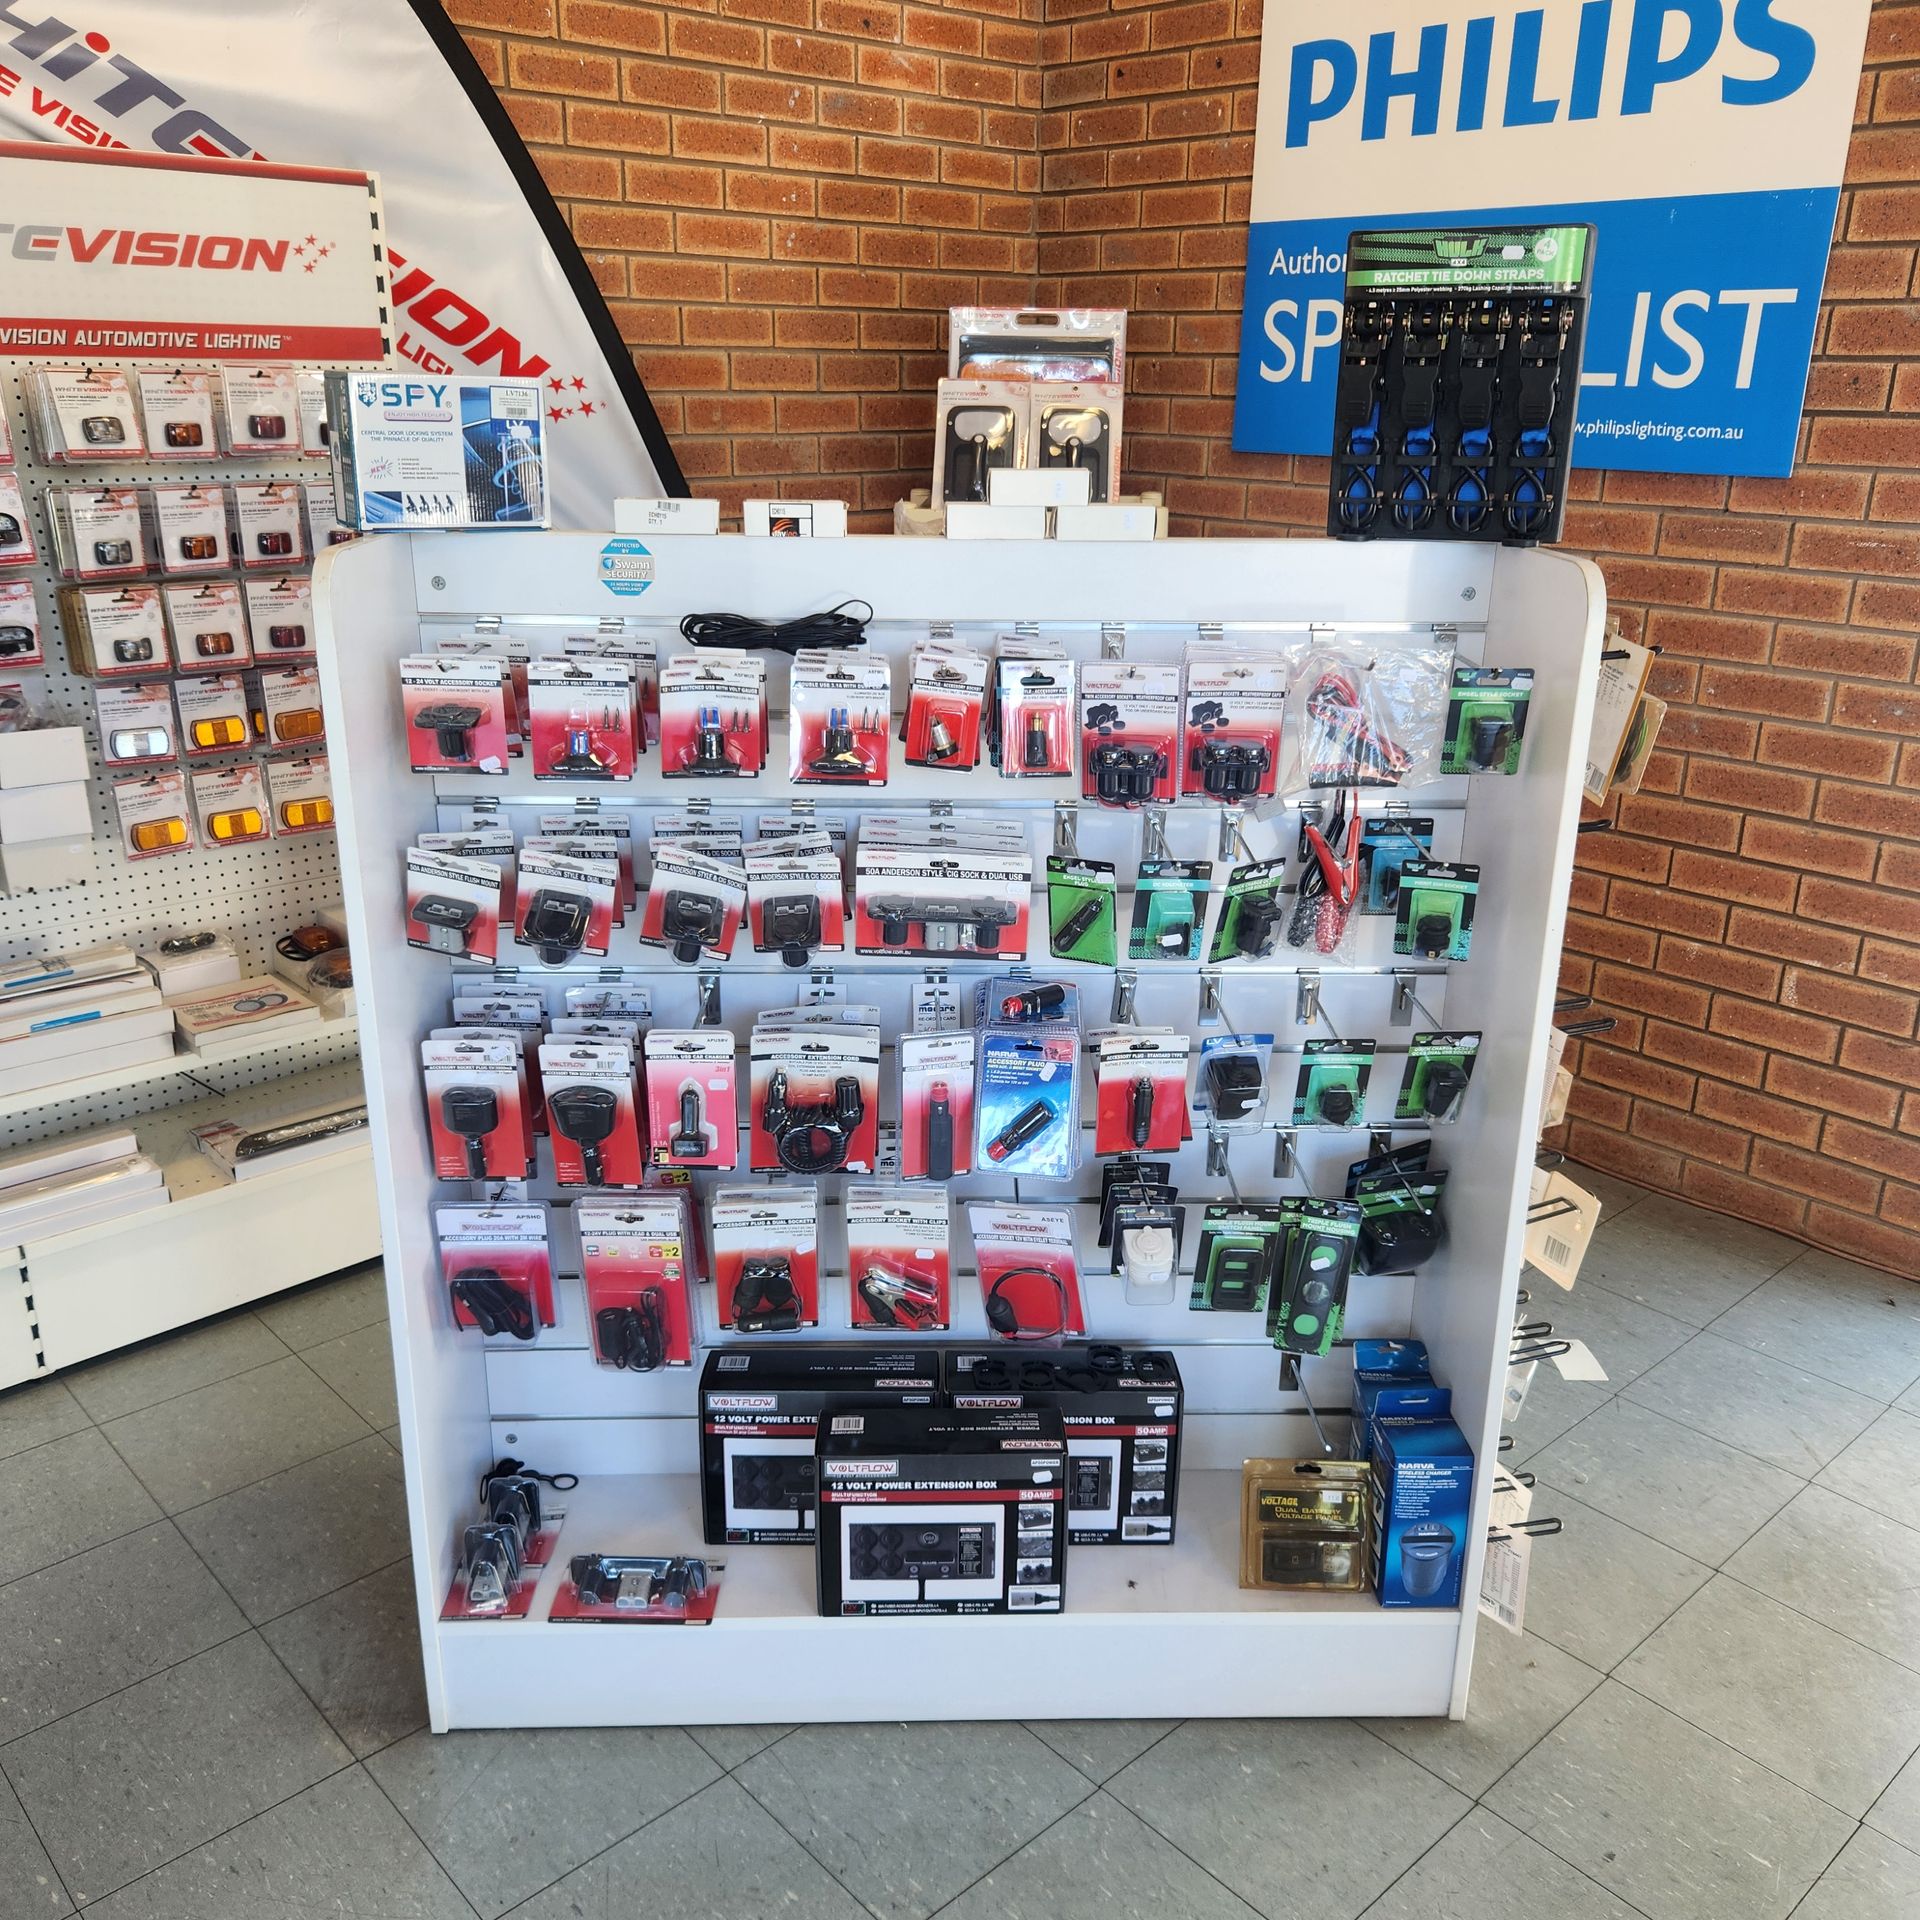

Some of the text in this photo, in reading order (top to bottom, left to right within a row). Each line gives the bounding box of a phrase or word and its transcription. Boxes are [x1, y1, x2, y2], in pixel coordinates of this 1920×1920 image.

[1284, 0, 1817, 149] PHILIPS
[1374, 269, 1545, 283] RATCHET TIE DOWN STRAPS
[74, 330, 198, 349] AUTOMOTIVE
[204, 333, 282, 350] LIGHTING
[381, 384, 448, 408] SPY
[942, 390, 990, 398] WHITEVISION
[610, 542, 641, 550] PROTECTED
[615, 559, 650, 570] Swann
[606, 570, 648, 580] SECURITY
[439, 679, 474, 687] ACCESSORY
[409, 863, 499, 889] 50A ANDERSON STYLE FLUSH MOUNT
[522, 865, 534, 873] 50A
[534, 866, 563, 877] ANDERSON
[563, 871, 580, 880] STYLE
[586, 874, 601, 883] DUAL
[602, 877, 613, 886] USB
[657, 862, 668, 870] 50A
[668, 864, 696, 877] ANDERSON
[696, 870, 712, 879] STYLE
[718, 875, 727, 884] CIG
[727, 878, 746, 890] SOCKET
[760, 873, 789, 881] ANDERSON
[820, 872, 840, 880] SOCKET
[865, 867, 1024, 881] 50A ANDERSON STYLE CIG SOCK & DUAL USB
[1206, 1037, 1224, 1045] LV
[987, 1050, 1019, 1058] NARVA
[988, 1058, 1027, 1066] ACCESSORY
[716, 1221, 750, 1229] ACCESSORY
[992, 1223, 1048, 1234] VOLTFLOW
[671, 1247, 680, 1257] 2
[711, 1398, 774, 1408] VOLTFLOW
[957, 1399, 1020, 1408] VOLTFLOW
[714, 1415, 726, 1423] 12
[727, 1415, 754, 1423] VOLT
[755, 1415, 791, 1424] POWER
[1095, 1416, 1116, 1425] BOX
[829, 1463, 895, 1473] VOLTFLOW
[831, 1480, 998, 1490] 12 VOLT POWER EXTENSION BOX
[1261, 1496, 1299, 1507] VOLTAGE
[1274, 1506, 1341, 1516] DUAL BATTERY
[1275, 1512, 1344, 1521] VOLTAGE PANEL
